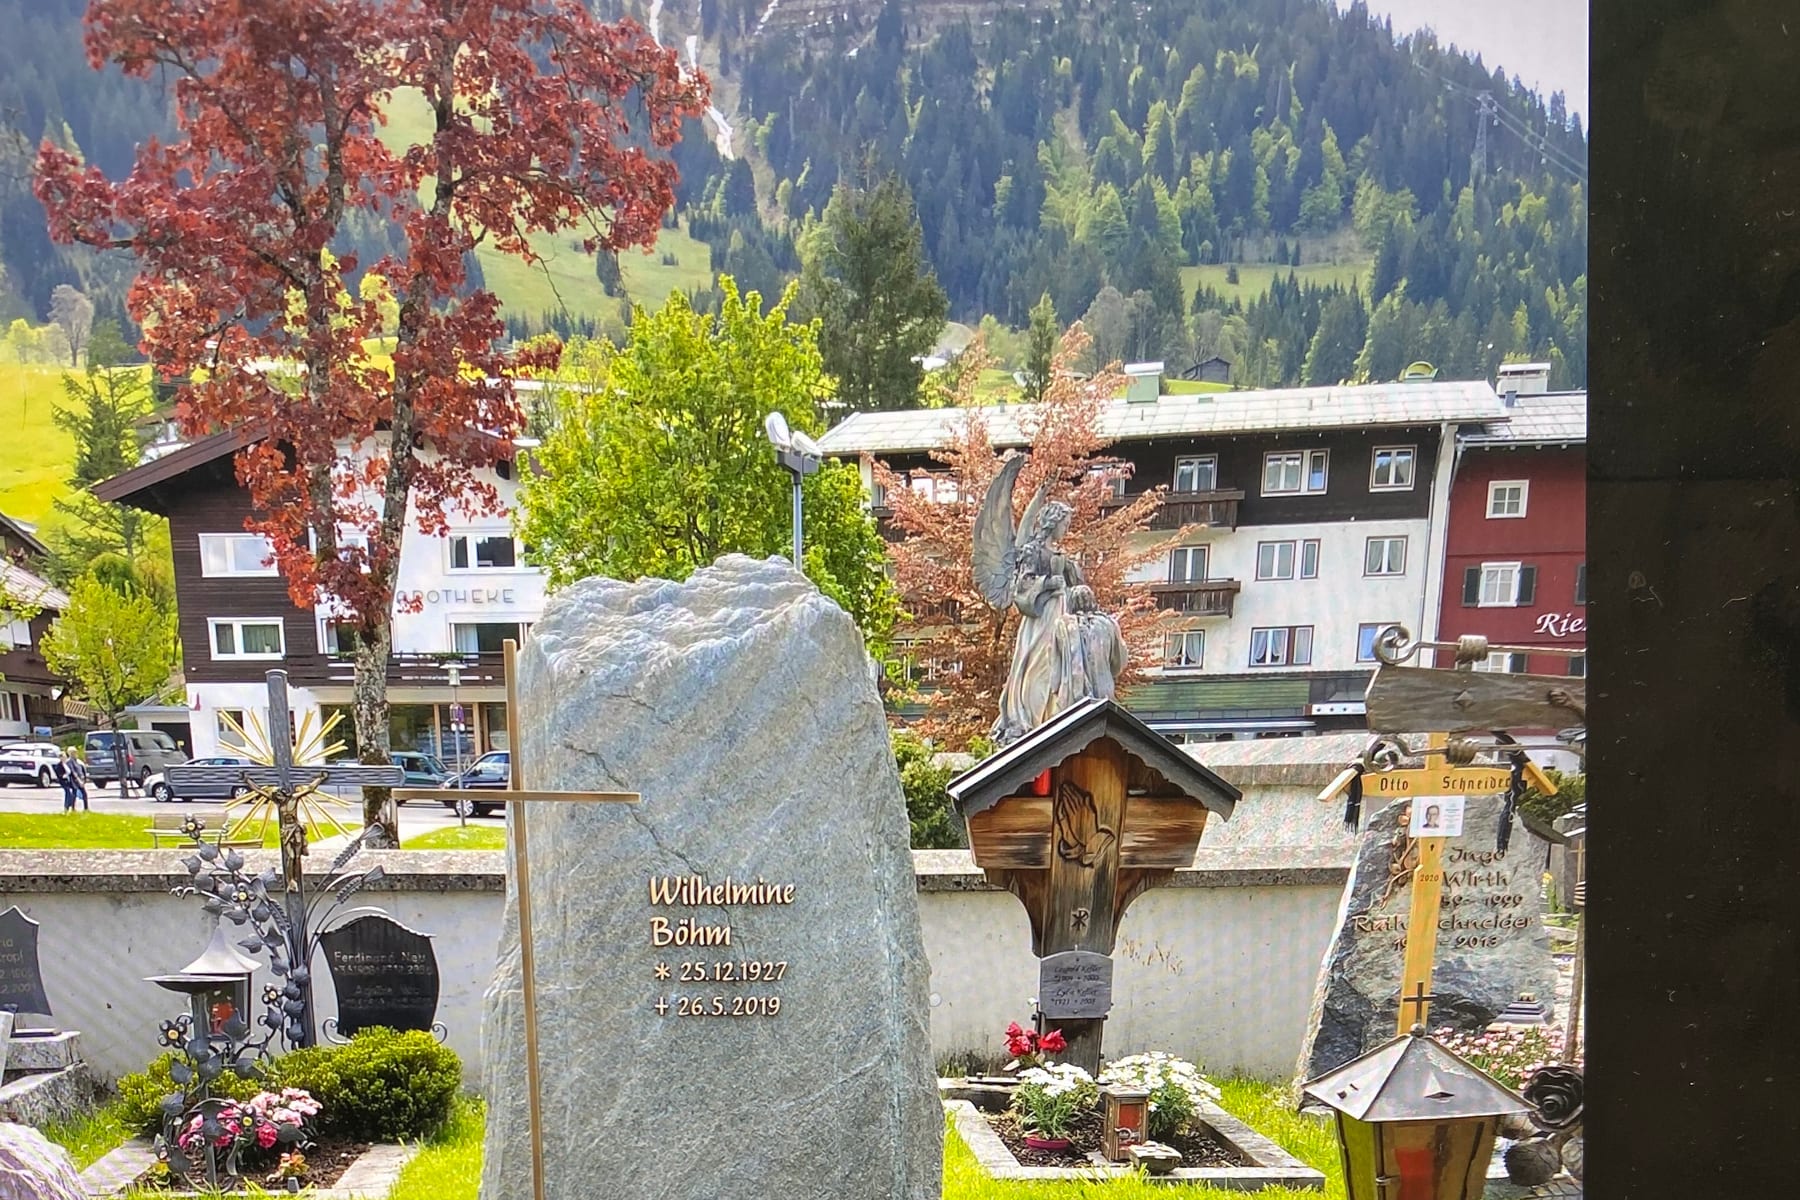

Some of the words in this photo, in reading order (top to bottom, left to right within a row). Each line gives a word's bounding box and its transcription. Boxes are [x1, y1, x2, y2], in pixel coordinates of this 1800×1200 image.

[1533, 612, 1587, 637] Rie
[1380, 777, 1409, 791] Otto
[1442, 776, 1511, 792] Schneider
[1449, 846, 1505, 866] Ingo
[1420, 874, 1440, 882] 2020
[650, 875, 796, 906] Wilhelmine
[651, 917, 732, 947] Böhm
[1437, 913, 1531, 931] chneider
[680, 961, 788, 982] 25.12.1927
[678, 996, 781, 1017] 26.5.2019
